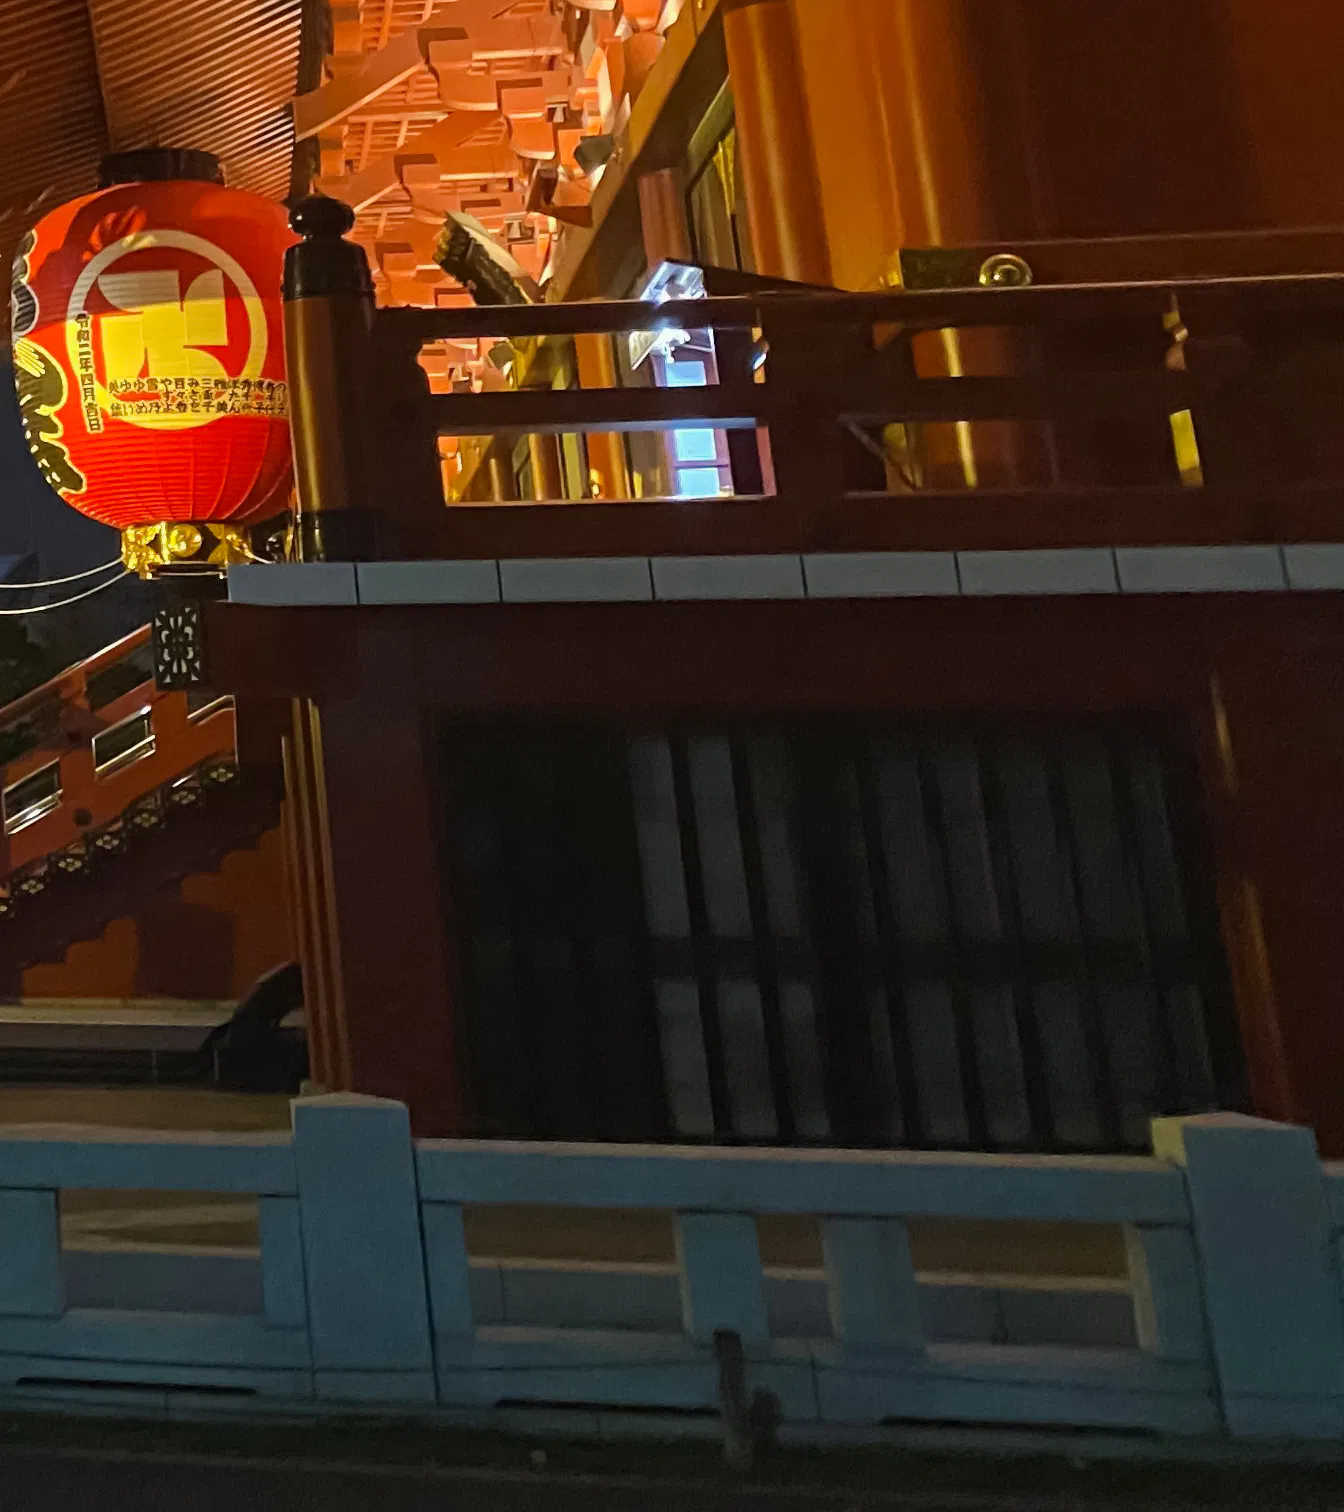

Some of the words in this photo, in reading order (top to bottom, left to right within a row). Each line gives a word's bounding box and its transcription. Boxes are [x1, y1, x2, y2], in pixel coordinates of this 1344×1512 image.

[76, 313, 101, 432] 令和二年四月吉日
